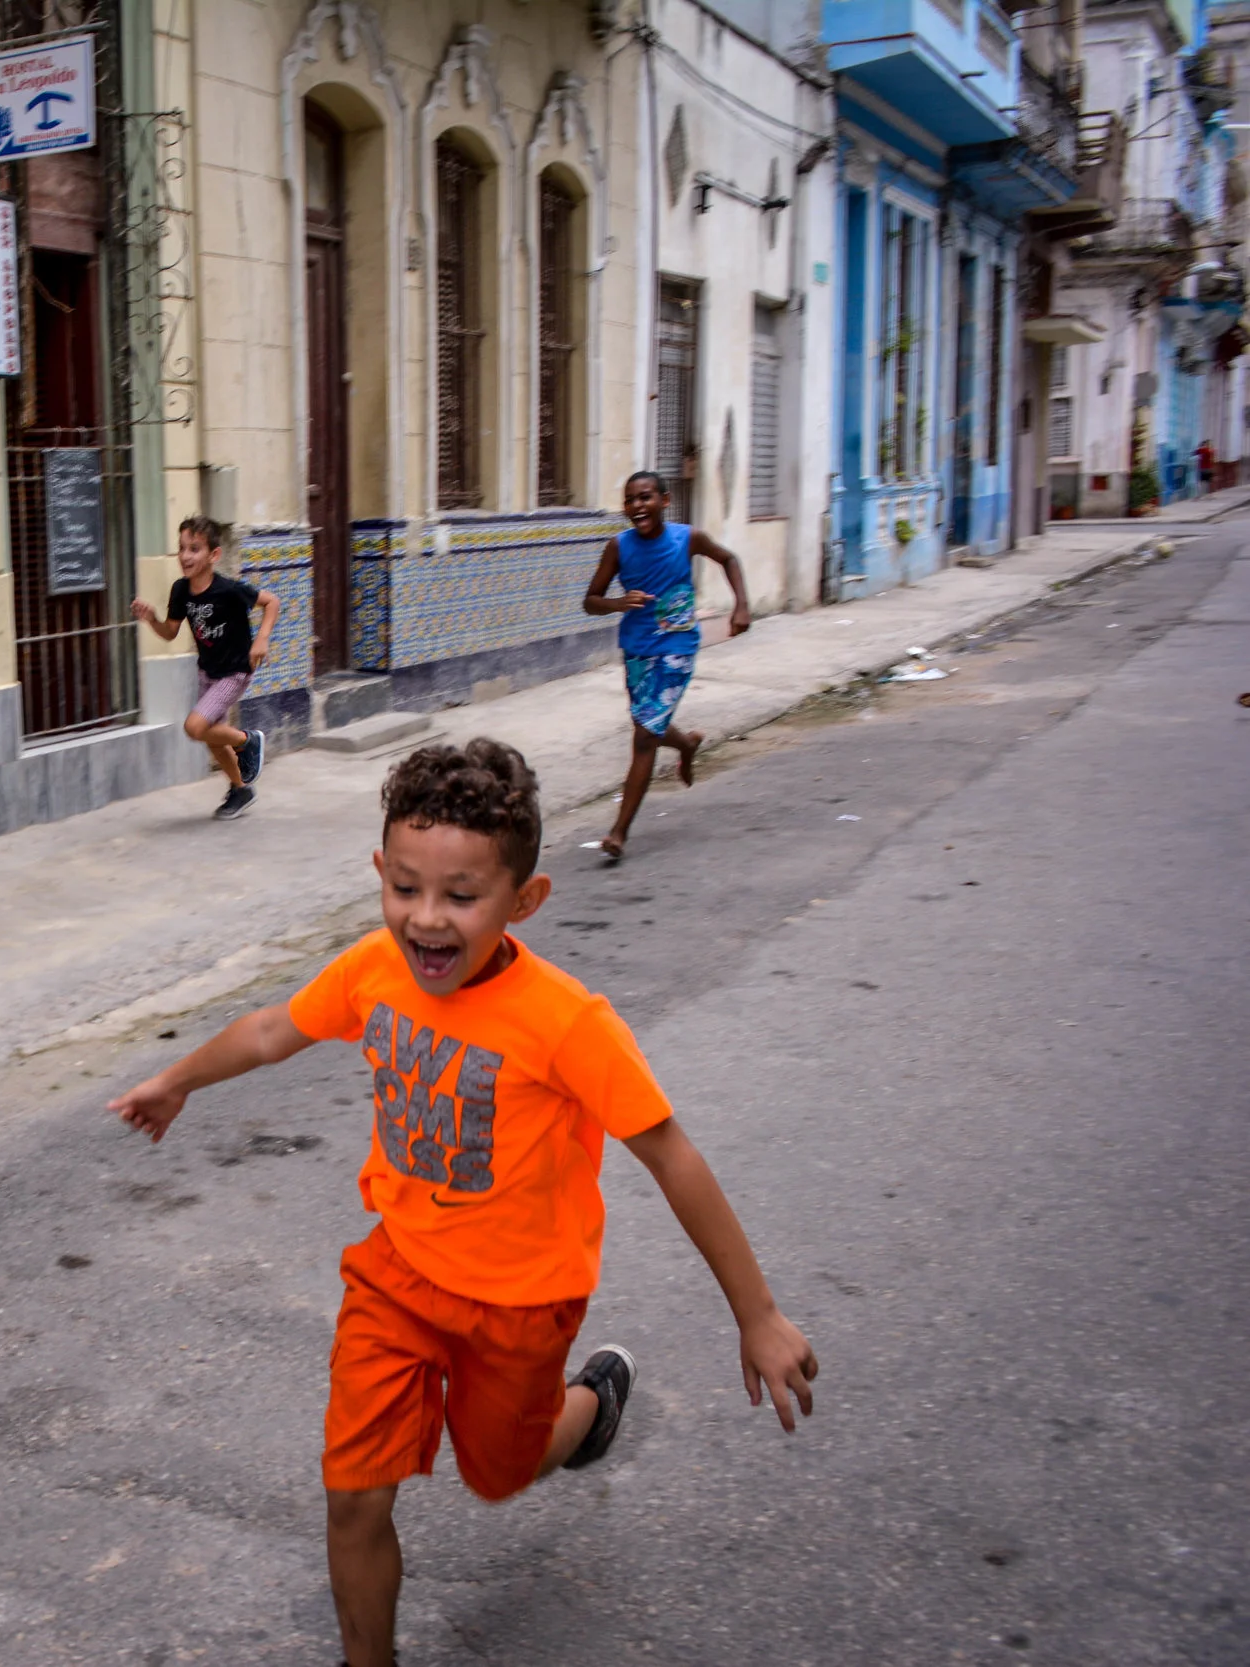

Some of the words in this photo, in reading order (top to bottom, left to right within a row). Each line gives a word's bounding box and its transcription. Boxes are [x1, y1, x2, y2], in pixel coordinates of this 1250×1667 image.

[9, 67, 78, 94] Leopoldo
[362, 1001, 504, 1102] AWE
[374, 1066, 496, 1150] OME
